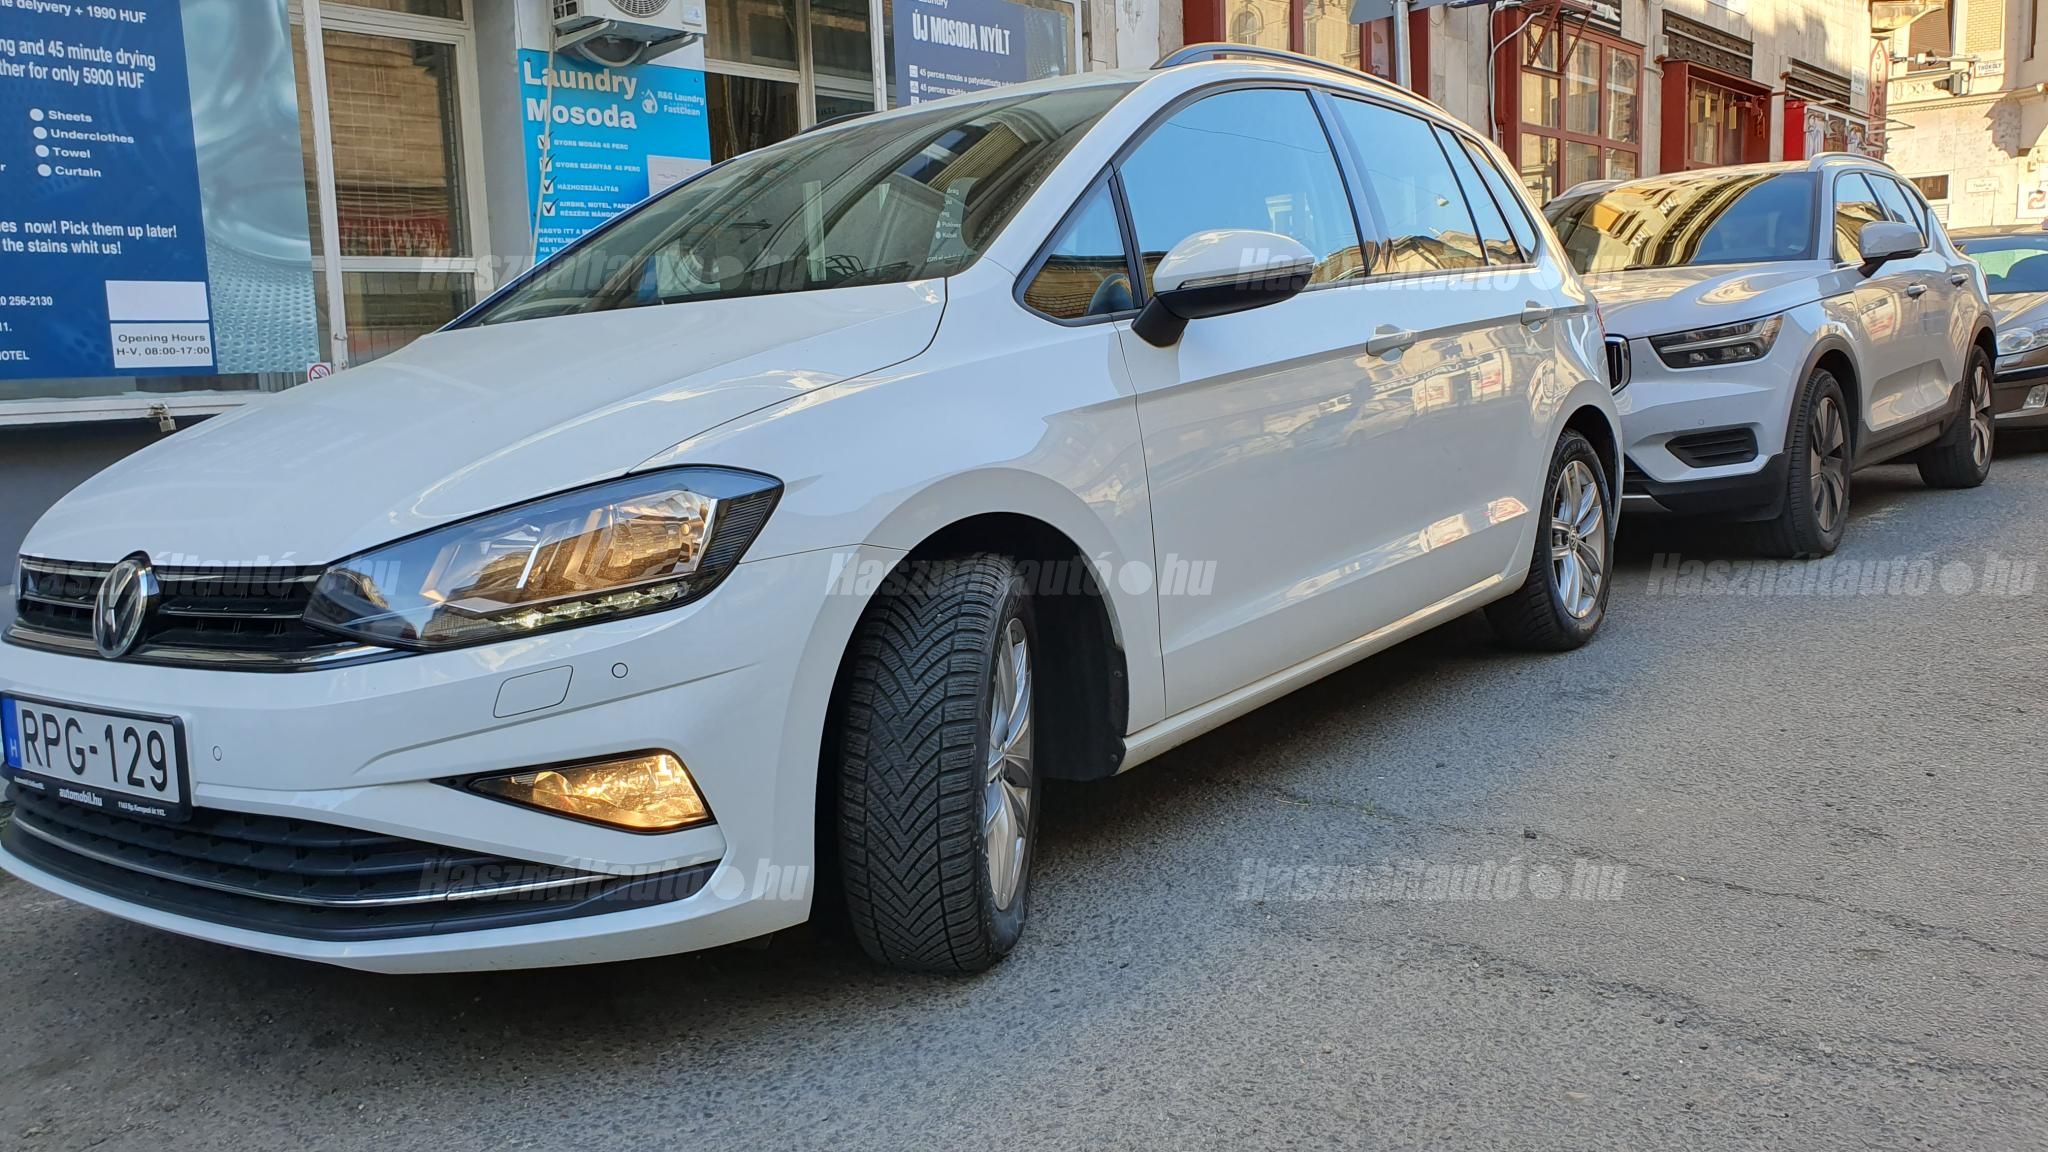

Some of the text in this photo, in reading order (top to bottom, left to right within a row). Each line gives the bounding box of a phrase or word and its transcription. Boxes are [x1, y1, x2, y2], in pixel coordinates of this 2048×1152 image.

[17, 0, 71, 16] delyvery
[75, 7, 83, 15] +
[87, 6, 116, 20] 1990
[120, 10, 147, 23] HUF
[912, 9, 1011, 56] ÚJ MOSODA NYÍLT
[19, 39, 44, 56] and
[48, 40, 64, 58] 45
[68, 44, 112, 63] minute
[116, 48, 156, 71] drying
[29, 62, 48, 80] for
[52, 66, 80, 86] only
[83, 67, 113, 86] 5900
[117, 71, 145, 89] HUF
[523, 61, 637, 100] Laundry
[674, 92, 705, 106] Laundry
[48, 111, 92, 123] Sheets
[526, 98, 638, 130] Mosoda
[663, 104, 701, 117] FastClean
[51, 129, 135, 144] Underclothes
[52, 147, 91, 159] Towel
[55, 166, 102, 178] Curtain
[25, 220, 57, 234] now!
[61, 221, 89, 235] Pick
[92, 222, 124, 237] them
[128, 225, 144, 240] up
[146, 224, 177, 239] later!
[2, 238, 122, 255] the stains whit us!
[8, 296, 53, 306] 256-2130
[118, 334, 206, 343] Opening Hours
[145, 347, 210, 356] 08:00-17:00
[10, 709, 168, 792] H RPG-129
[59, 788, 103, 807] automobil.hu
